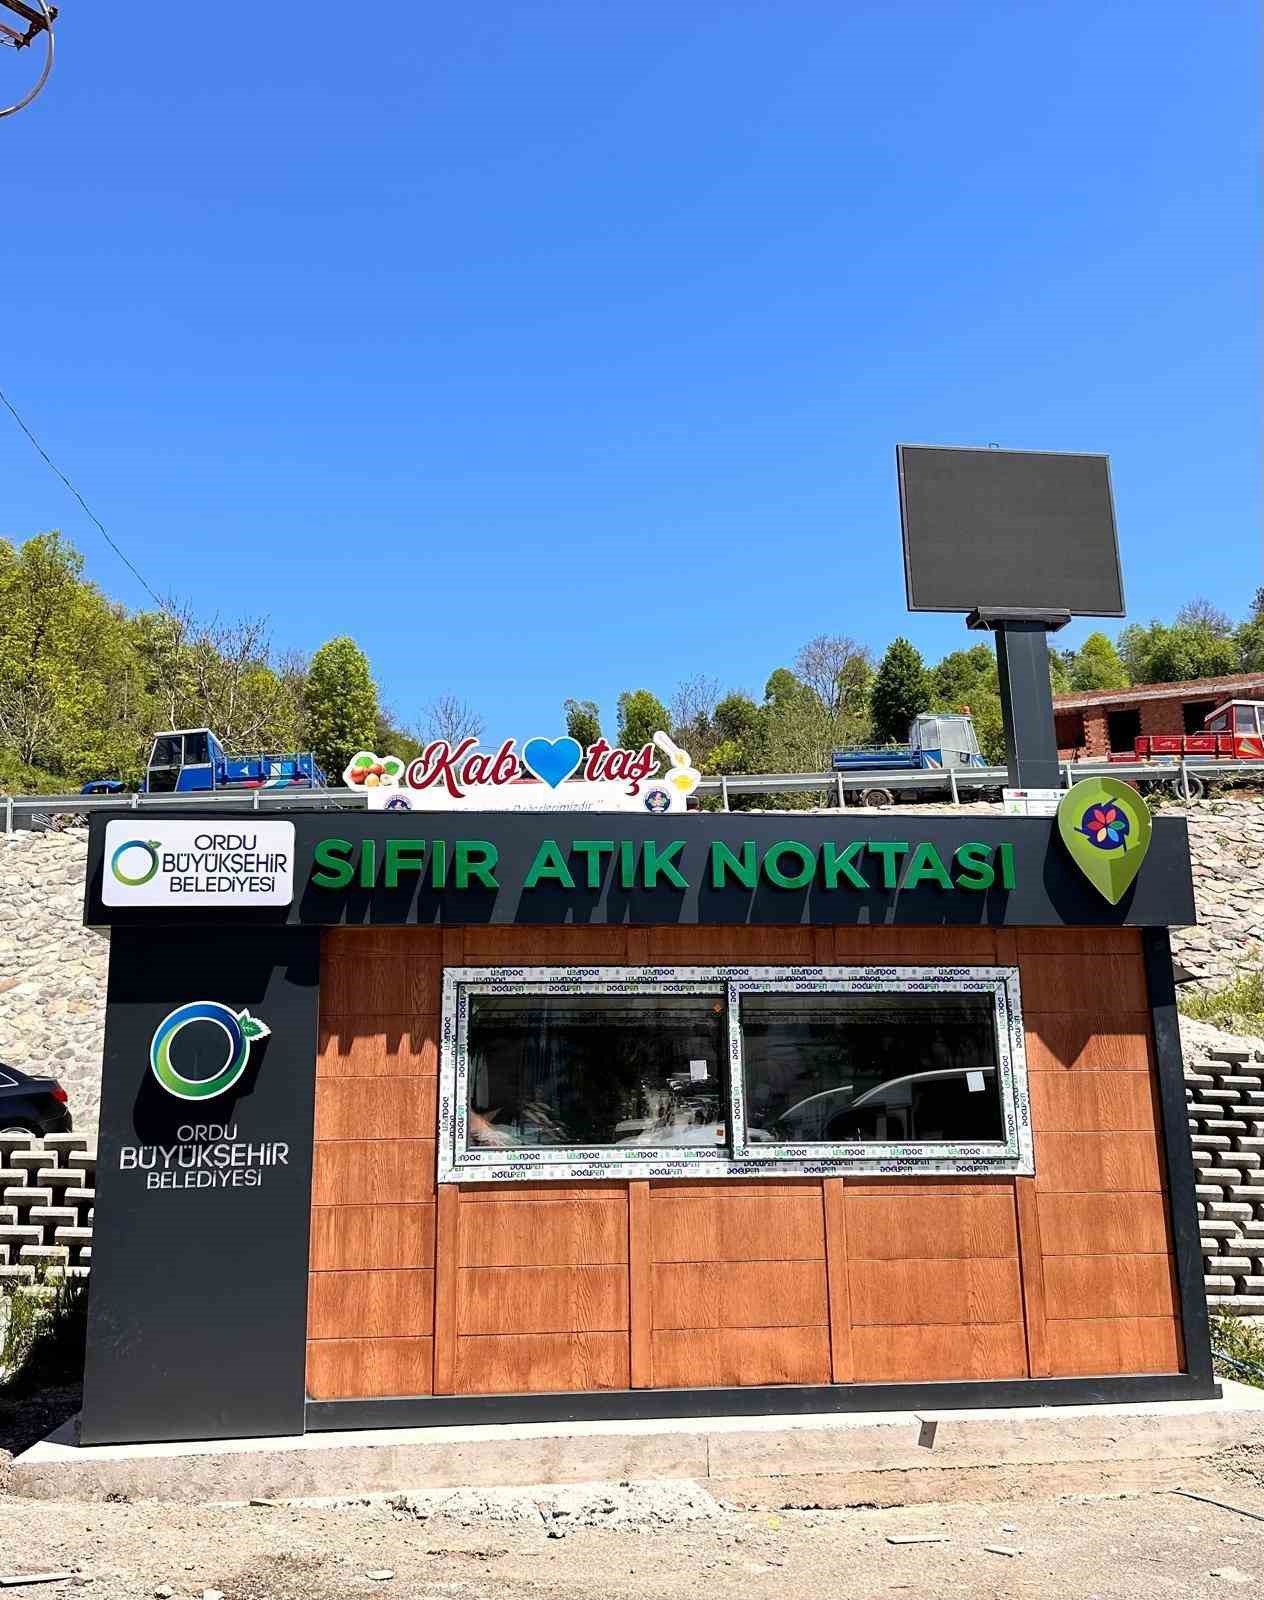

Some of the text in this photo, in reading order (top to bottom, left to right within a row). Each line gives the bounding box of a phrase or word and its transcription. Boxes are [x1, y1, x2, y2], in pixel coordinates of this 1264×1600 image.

[407, 738, 660, 798] Kab taş
[194, 834, 257, 851] ORDU
[313, 836, 1018, 891] SIFIR ATIK NOKTASI
[176, 1123, 238, 1142] ORDU
